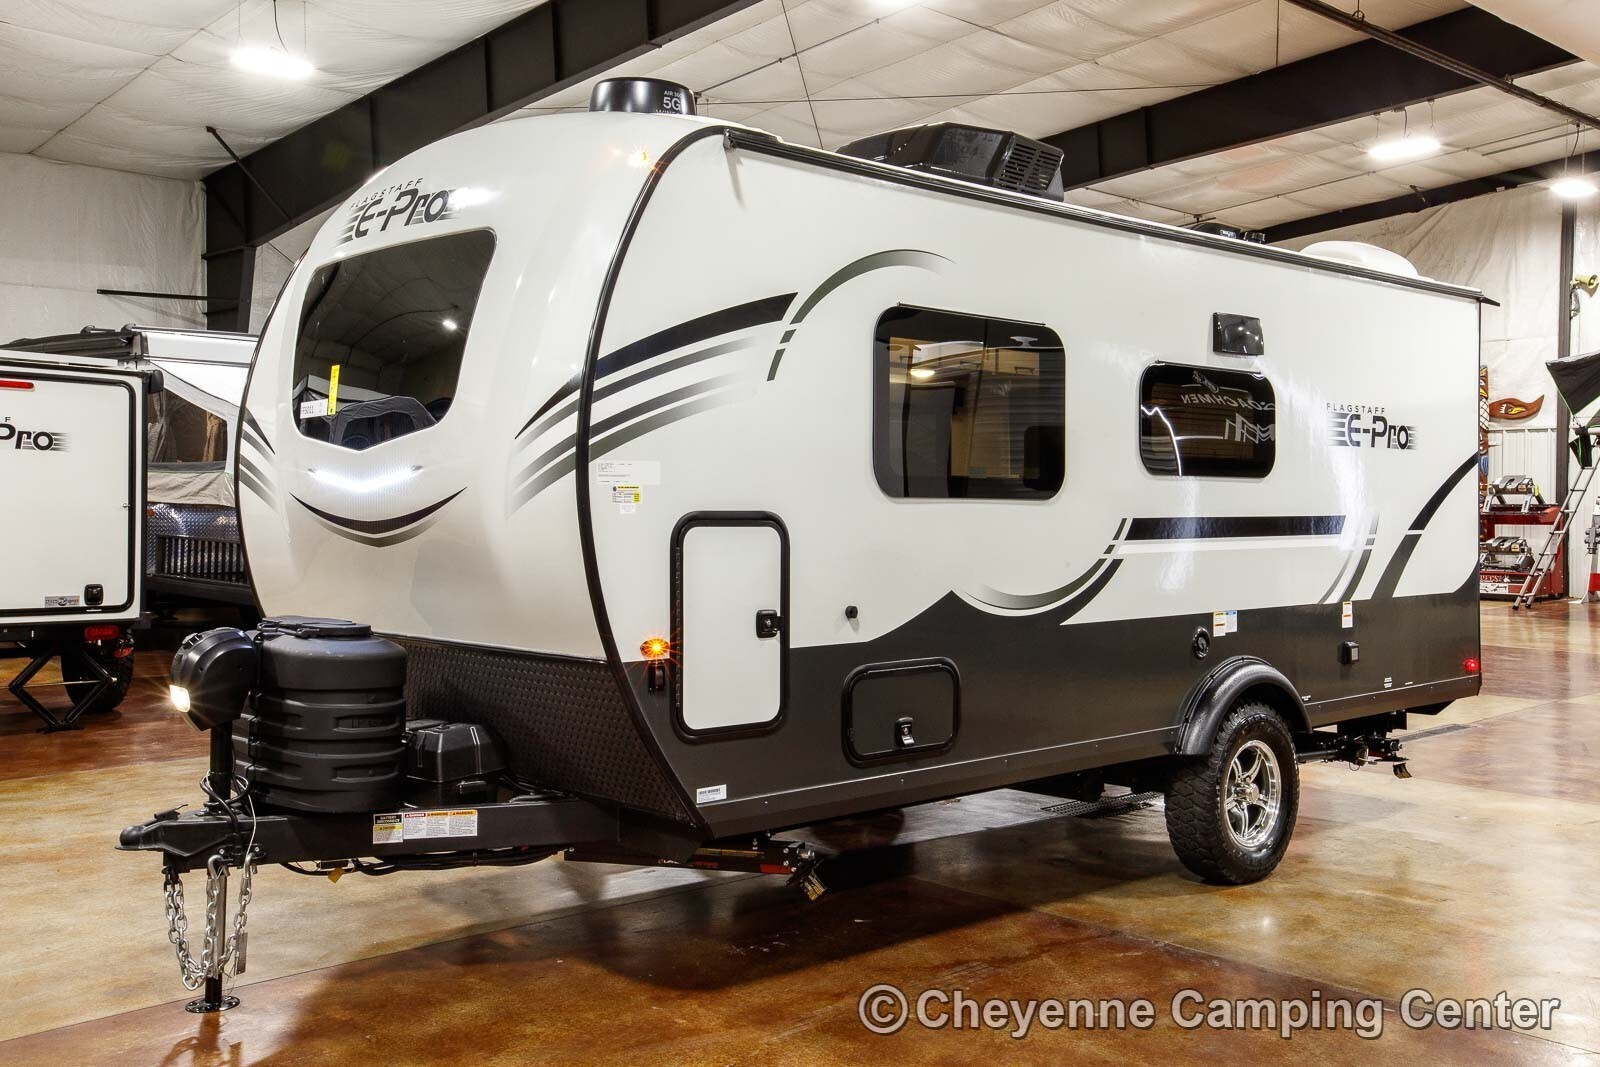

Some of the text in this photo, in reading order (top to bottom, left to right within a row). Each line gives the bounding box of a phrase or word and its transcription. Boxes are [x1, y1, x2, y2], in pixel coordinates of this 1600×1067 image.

[663, 96, 681, 110] 5G
[351, 177, 424, 209] FLAGSTAFF
[355, 188, 449, 238] E-Pro
[1326, 402, 1386, 415] FLAGSTAFF
[1347, 413, 1410, 450] E-Pro
